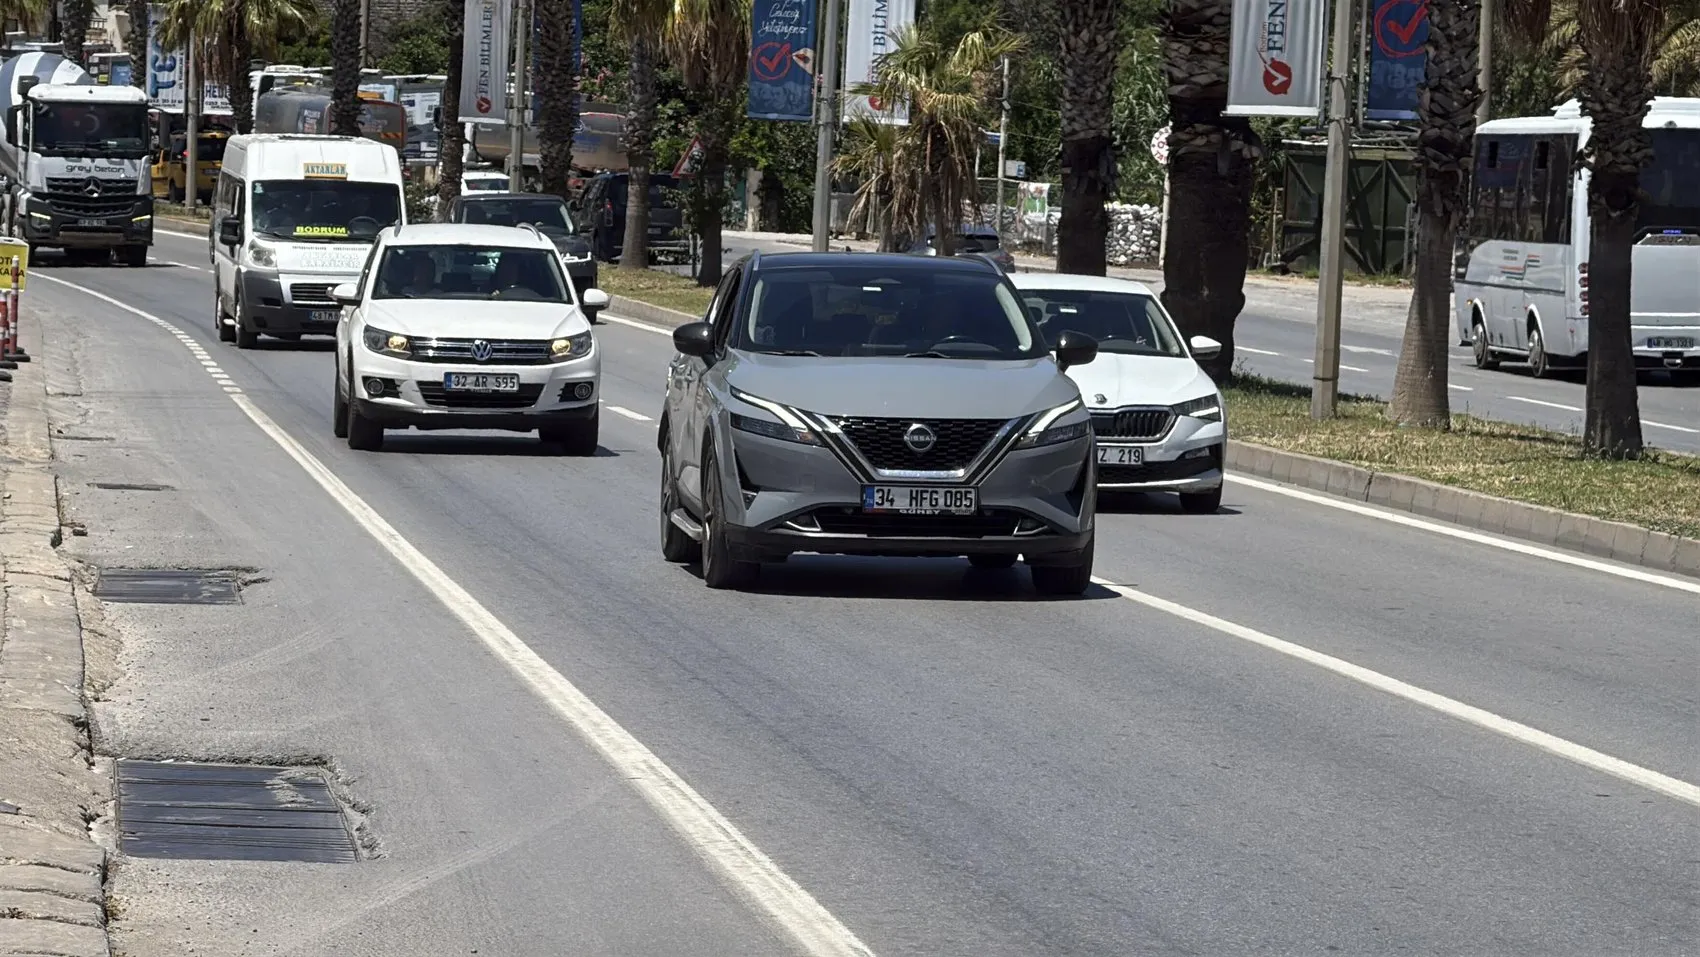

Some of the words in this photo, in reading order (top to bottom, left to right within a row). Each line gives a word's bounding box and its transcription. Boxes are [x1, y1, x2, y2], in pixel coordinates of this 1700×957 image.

[1267, 1, 1285, 54] FEN
[65, 165, 92, 173] grey
[94, 165, 125, 173] beton
[296, 226, 346, 234] BODRUM
[454, 375, 467, 387] 32
[474, 375, 488, 388] AR
[495, 376, 516, 389] 595
[1118, 448, 1141, 463] 219
[875, 488, 895, 507] 34
[909, 488, 939, 508] HFG
[944, 489, 973, 508] 085
